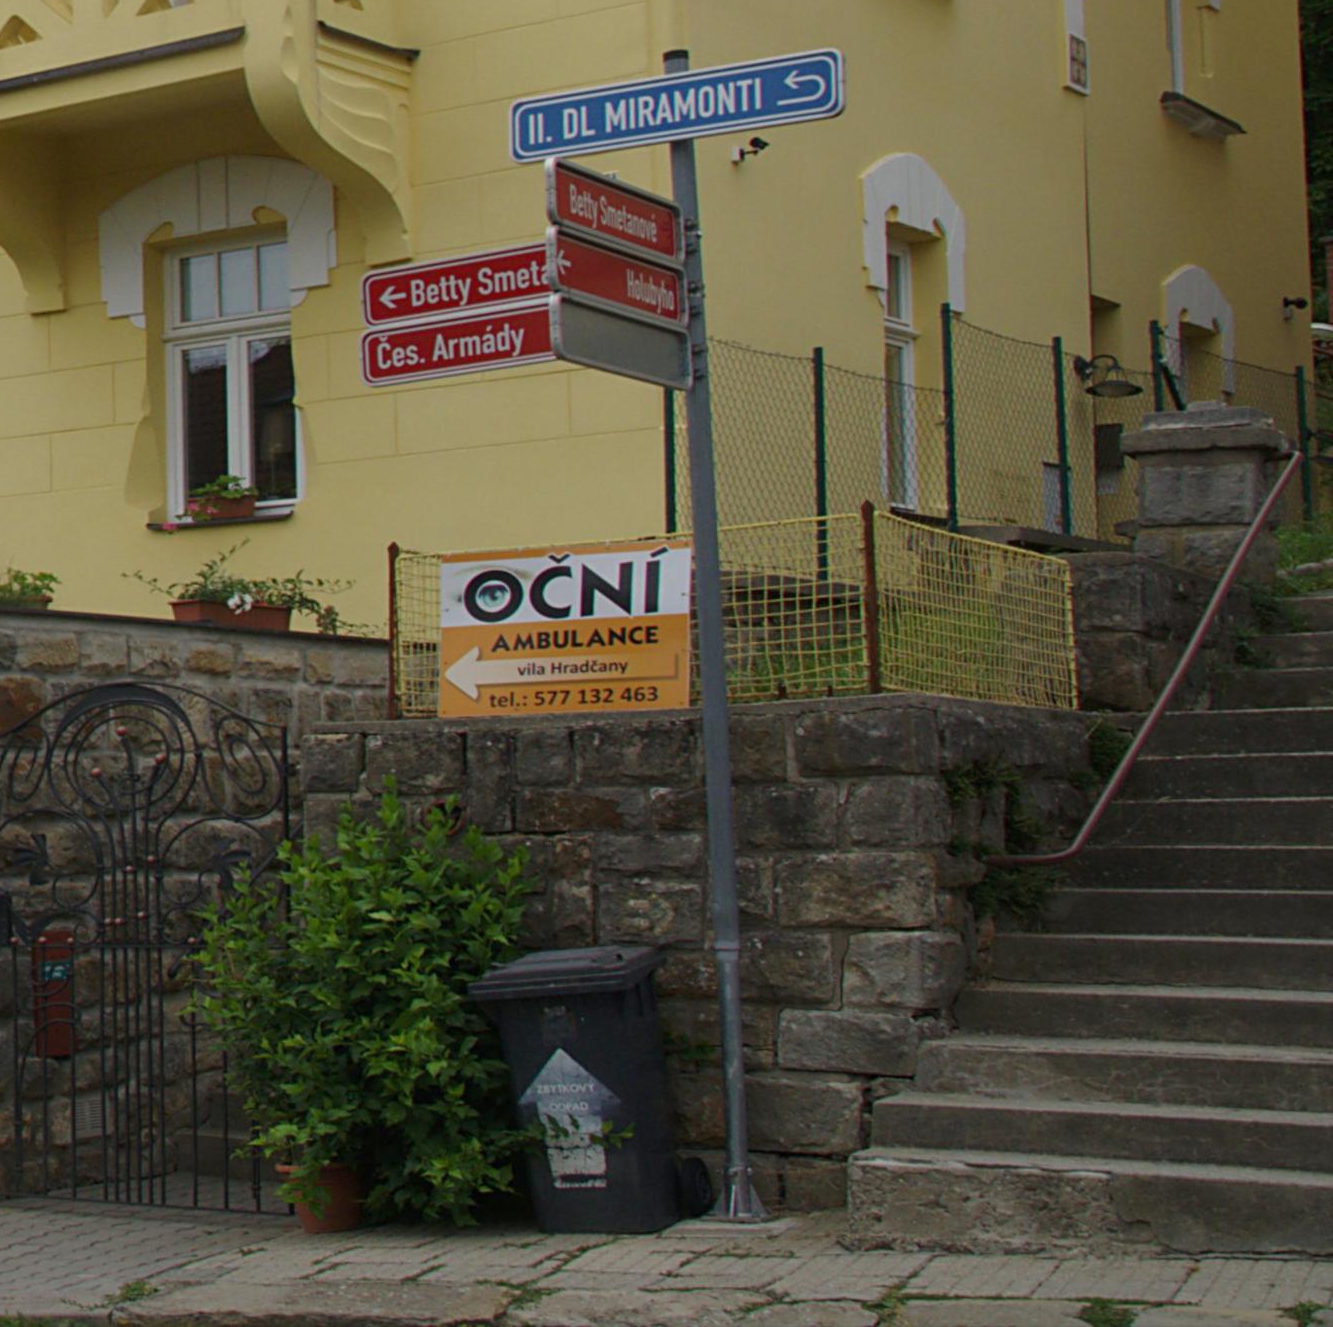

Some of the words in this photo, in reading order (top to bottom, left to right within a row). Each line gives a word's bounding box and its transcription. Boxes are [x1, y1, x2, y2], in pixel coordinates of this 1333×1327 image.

[528, 113, 552, 145] II.
[563, 106, 595, 140] DL
[605, 78, 762, 133] MIRAMONTI
[569, 183, 598, 229] Betty
[600, 195, 658, 243] Smetanové
[410, 274, 471, 308] Betty
[477, 260, 550, 296] Smeta
[626, 268, 674, 314] Holubyho
[377, 333, 426, 370] Čes.
[432, 322, 524, 362] Armády
[463, 546, 669, 623] OČNÍ
[491, 625, 659, 653] AMBULANCE
[517, 660, 545, 676] vila
[551, 659, 629, 676] Hradčany
[489, 692, 529, 708] tel.:
[534, 690, 570, 708] 577
[578, 688, 614, 705] 132
[620, 686, 659, 703] 463
